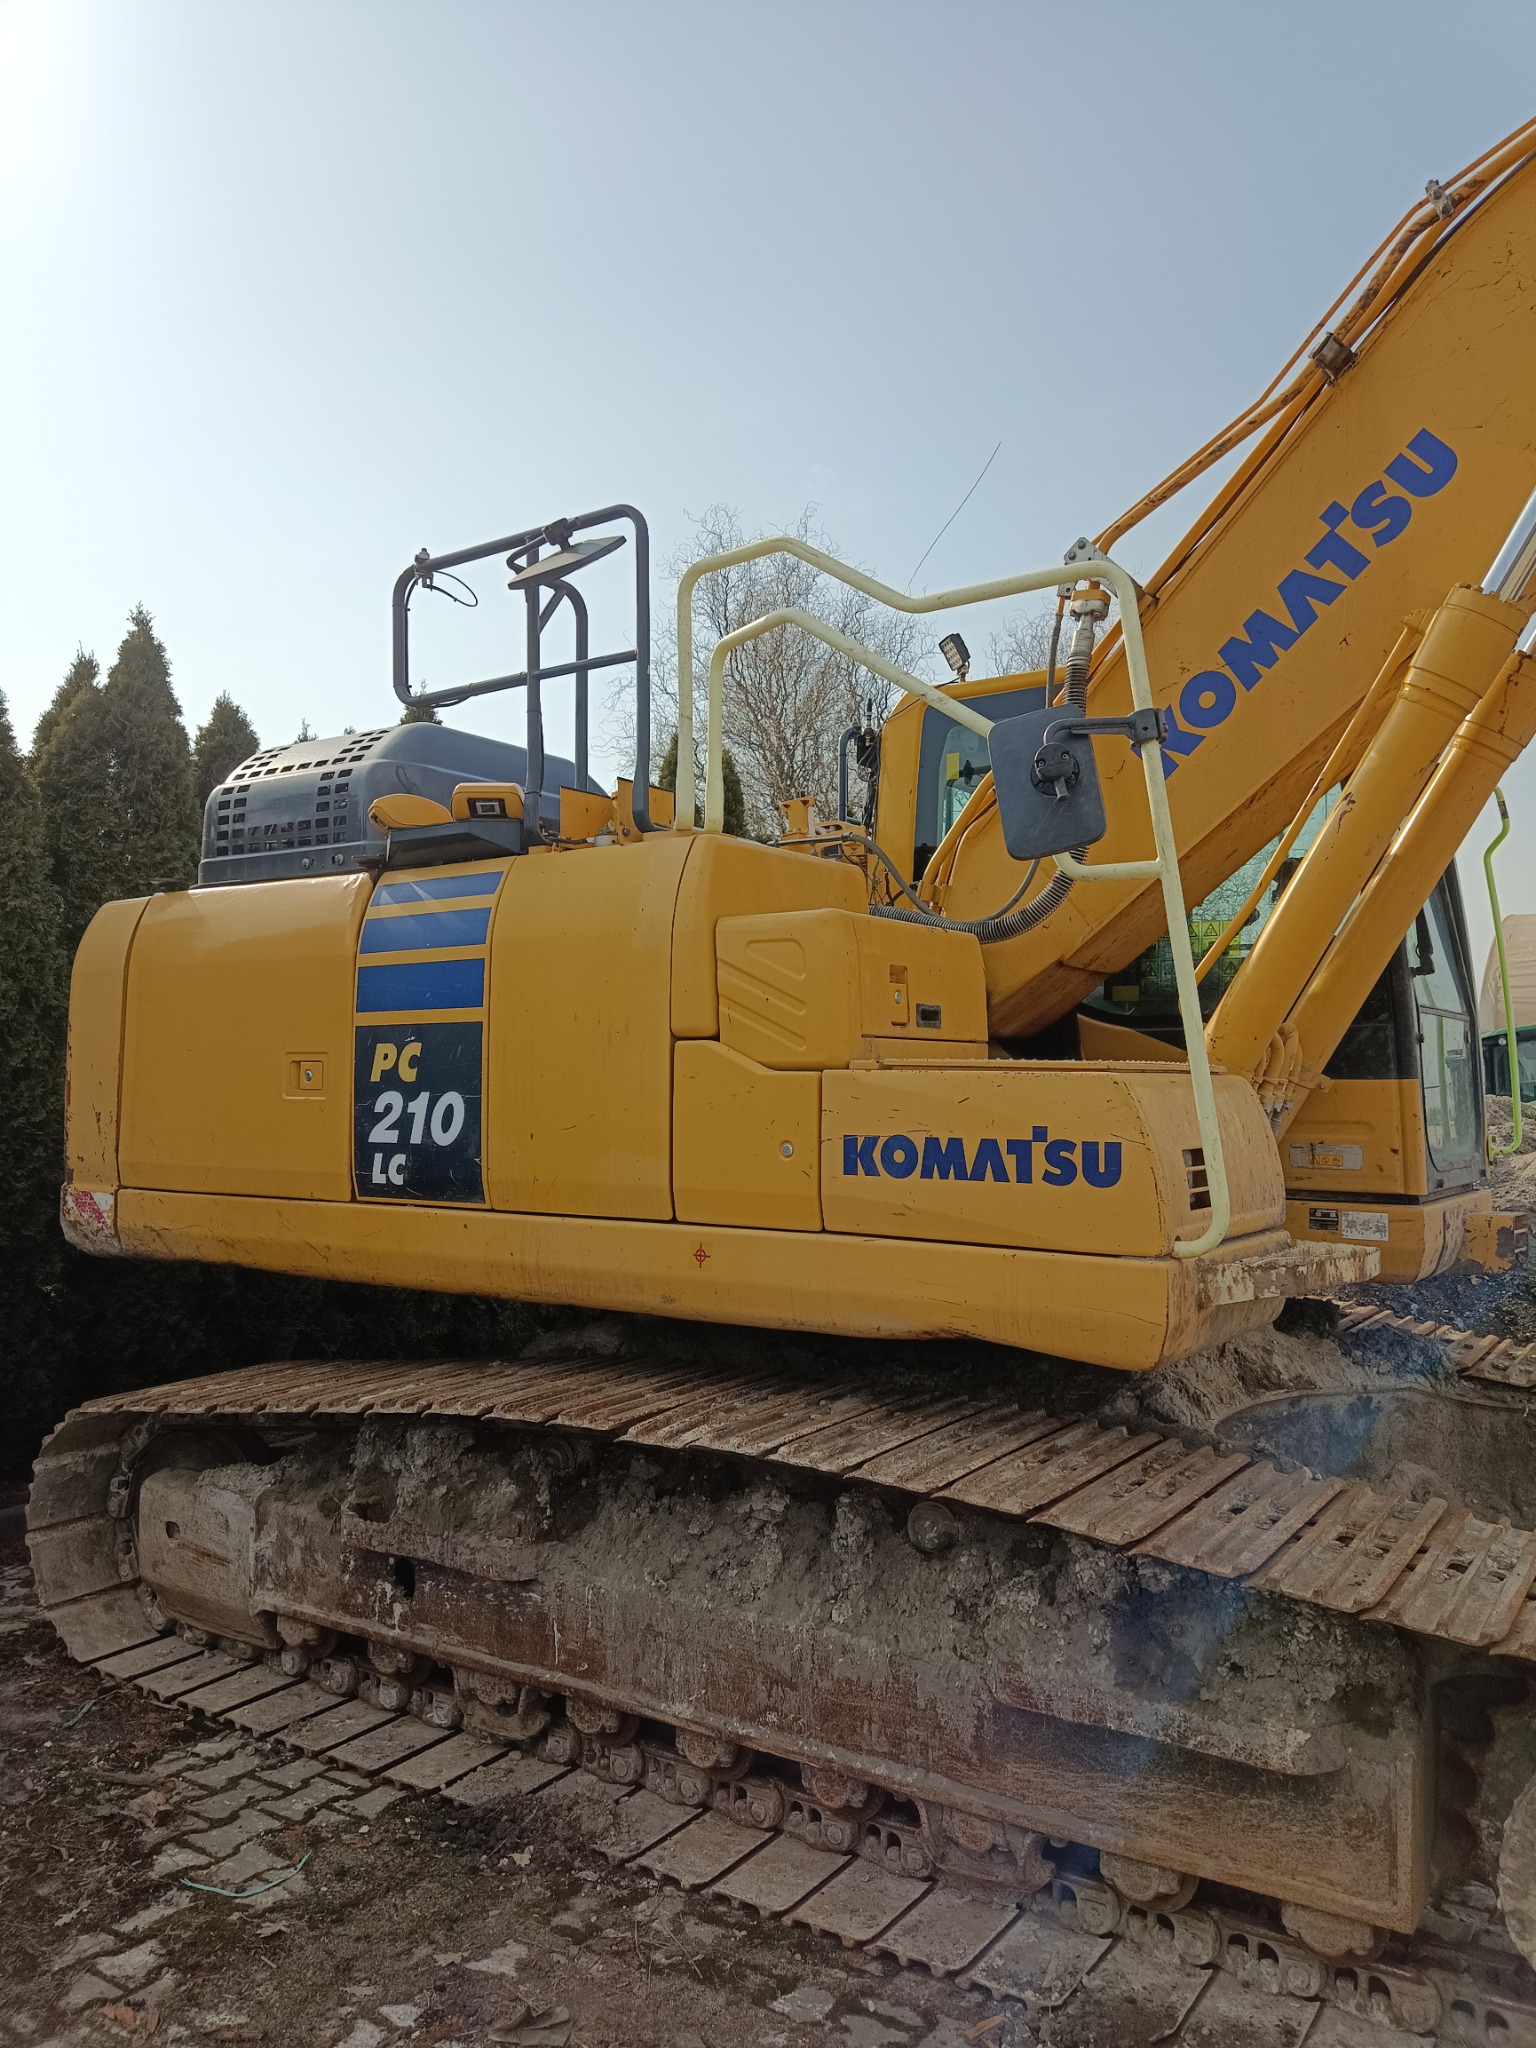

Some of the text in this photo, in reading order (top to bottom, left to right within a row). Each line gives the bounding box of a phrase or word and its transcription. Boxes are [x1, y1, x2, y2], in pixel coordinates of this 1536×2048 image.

[370, 1042, 422, 1083] PC
[368, 1090, 465, 1147] 210
[372, 1153, 407, 1186] LC
[843, 1126, 1122, 1187] KOMATSU
